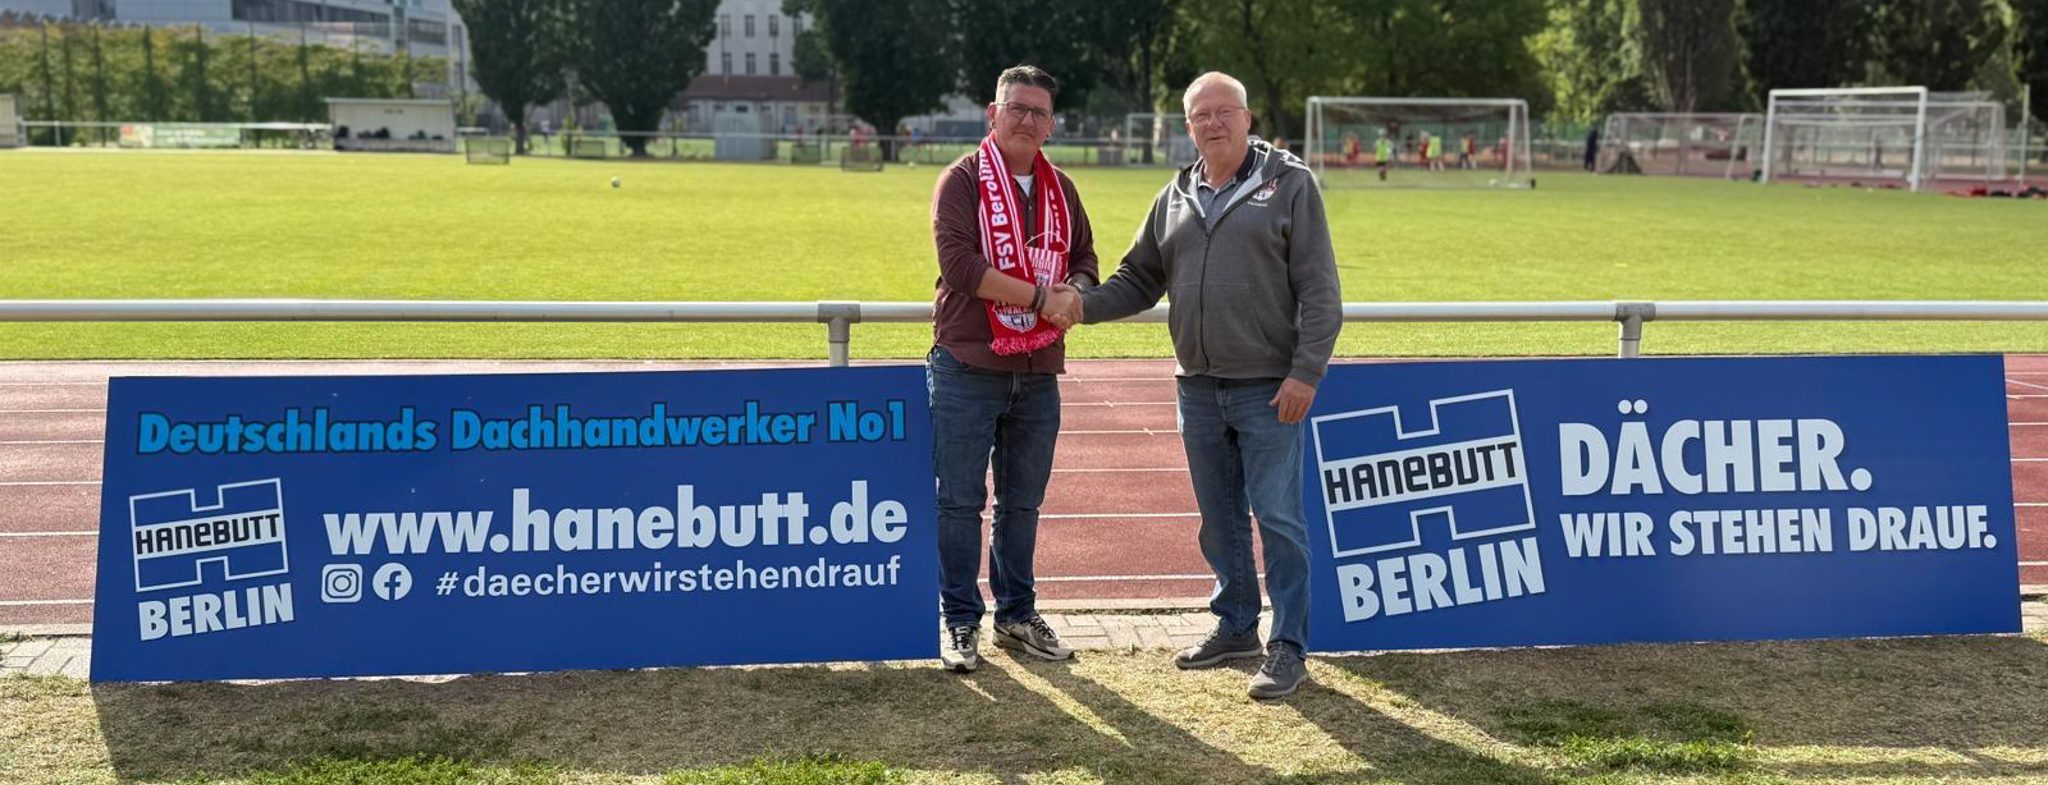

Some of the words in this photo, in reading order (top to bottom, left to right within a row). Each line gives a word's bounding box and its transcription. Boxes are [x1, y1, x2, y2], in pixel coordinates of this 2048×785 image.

[993, 231, 1016, 271] FSV
[137, 406, 439, 455] Deutschlands
[451, 400, 818, 450] Dachhandwerker
[825, 399, 906, 443] No1
[1559, 399, 1873, 496] DÄCHER.
[323, 480, 908, 555] www.hanebutt.de
[1559, 512, 1657, 558] WIR
[1668, 508, 1833, 557] STEHEN
[1848, 505, 1998, 551] DRAUF.
[435, 555, 901, 597] #daecherwirstehendrauf
[1336, 537, 1546, 623] BERLIN
[138, 583, 294, 641] BERLIN
